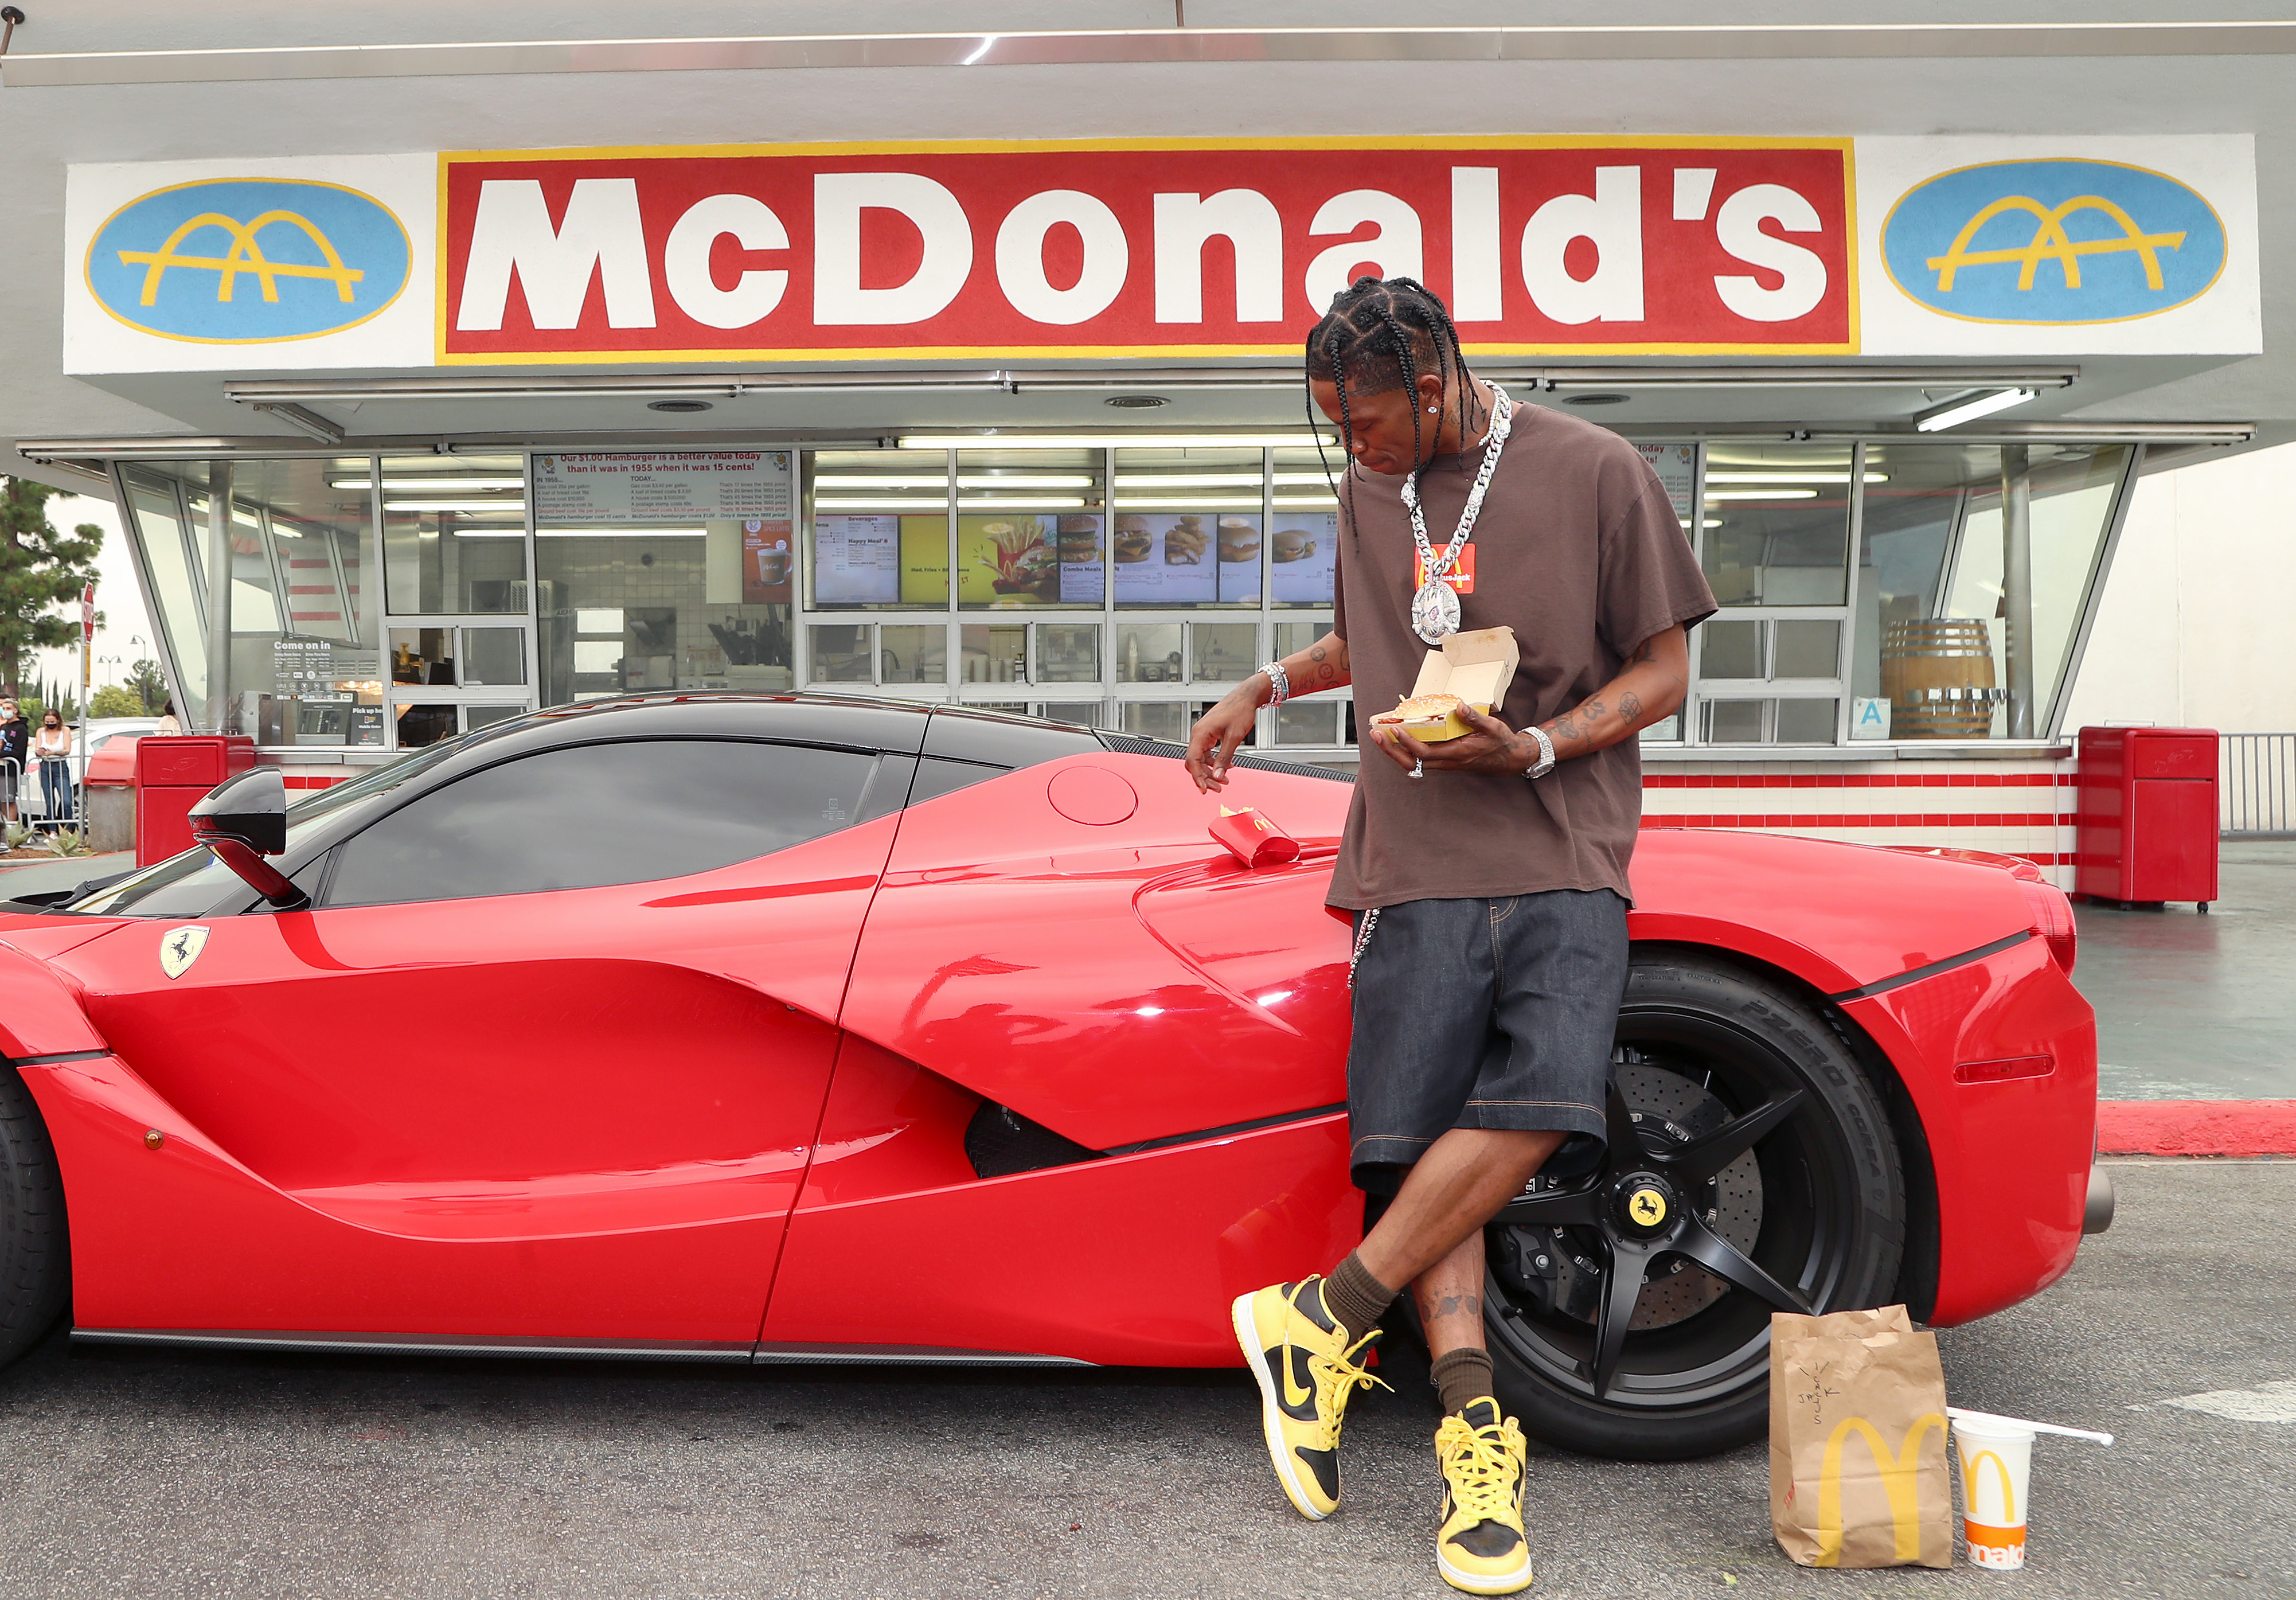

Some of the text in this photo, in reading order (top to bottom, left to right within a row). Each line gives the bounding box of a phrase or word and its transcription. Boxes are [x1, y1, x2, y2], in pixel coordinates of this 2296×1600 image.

[455, 165, 1826, 331] McDonald's
[606, 453, 657, 462] Hamburger
[735, 452, 761, 461] today
[274, 641, 304, 650] Come
[320, 641, 331, 650] in
[1860, 700, 1883, 724] A
[1847, 1103, 1881, 1178] CORSA
